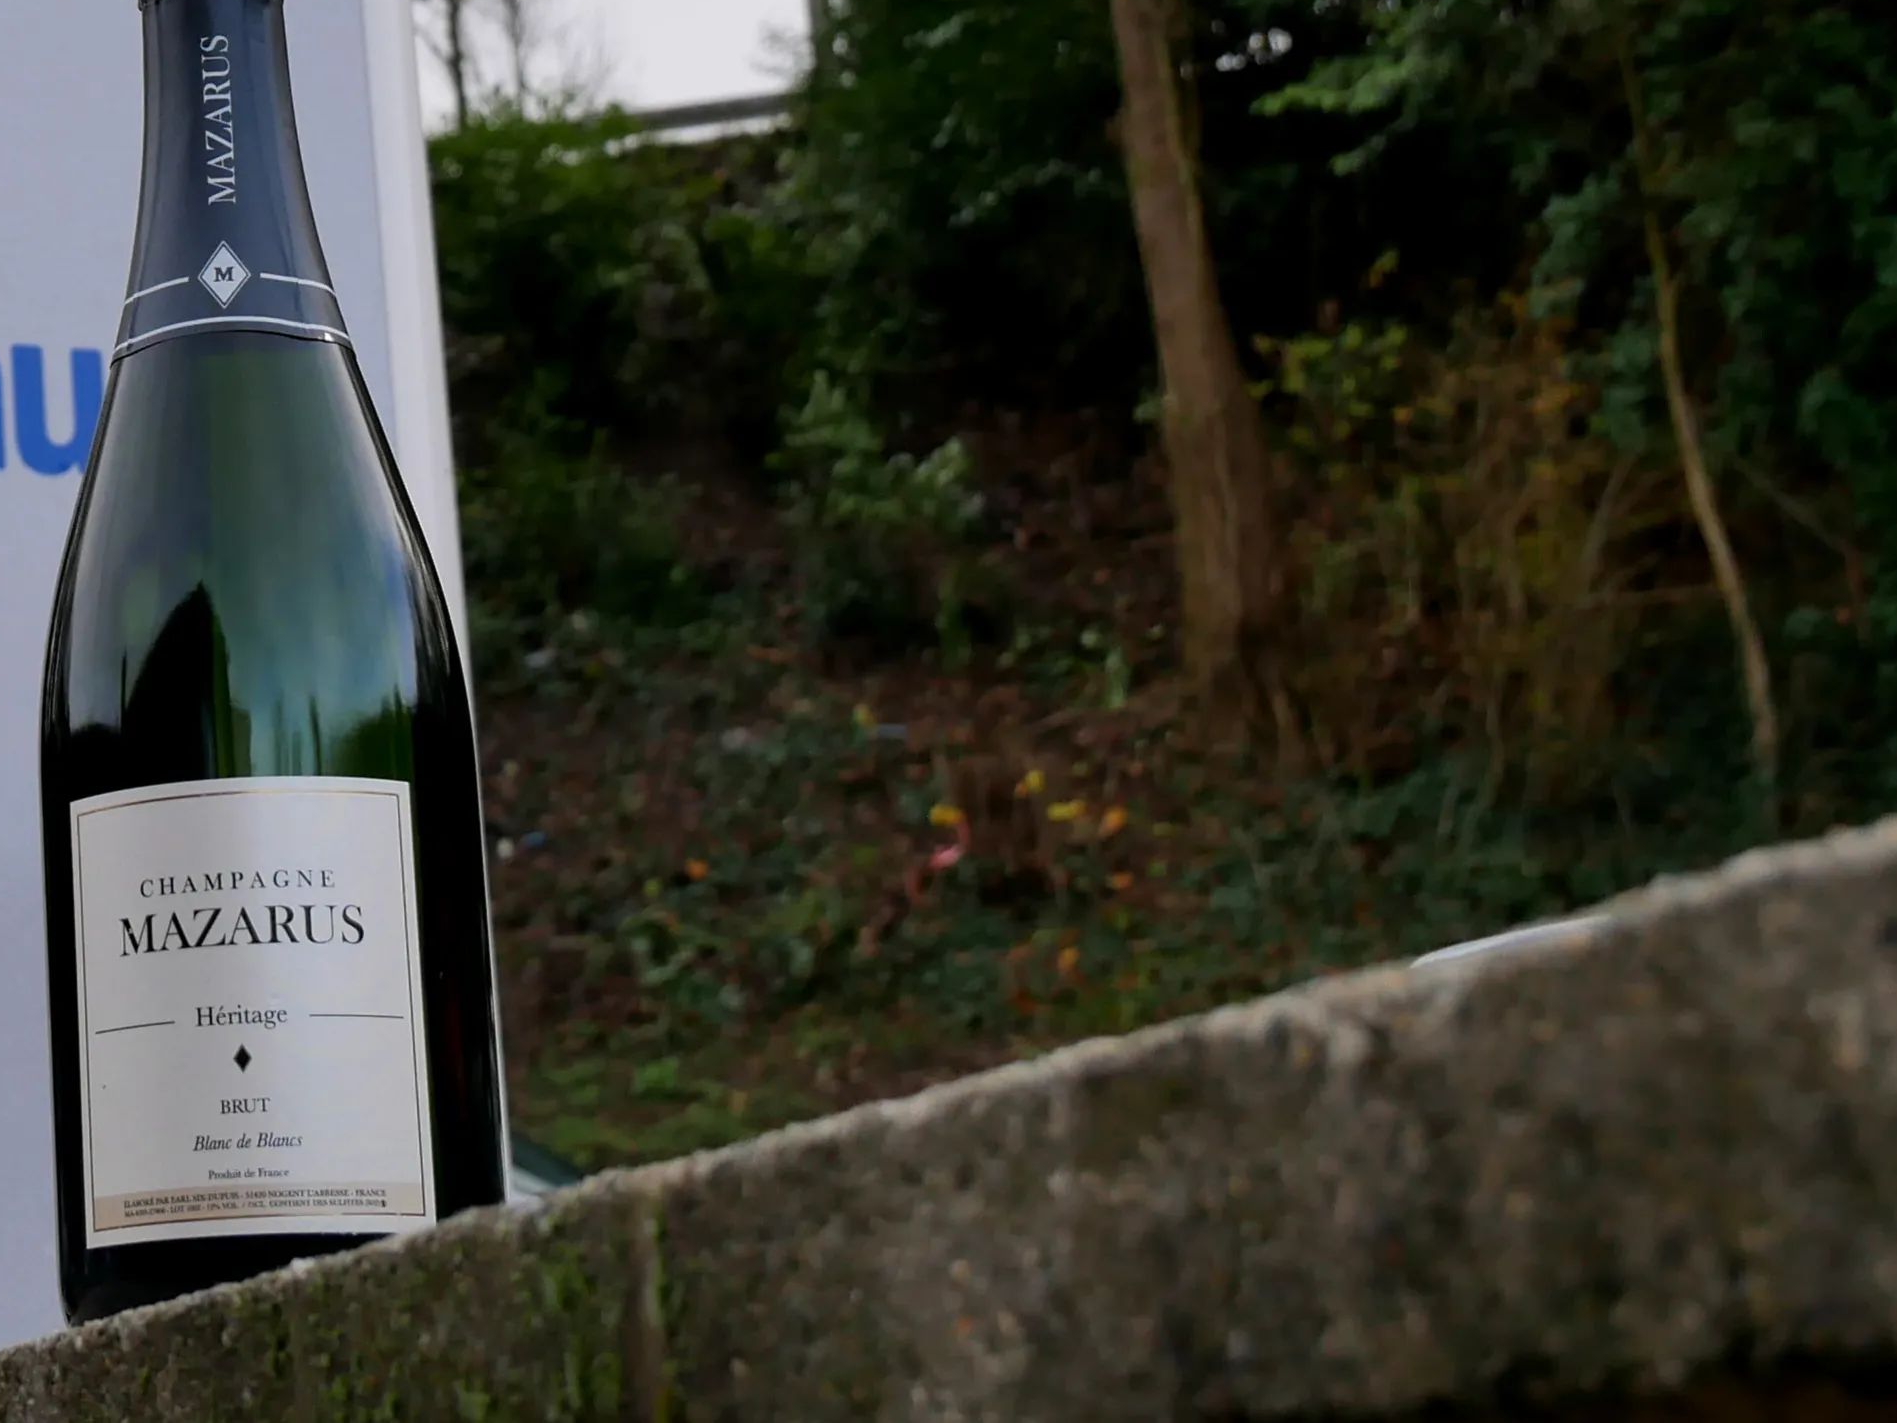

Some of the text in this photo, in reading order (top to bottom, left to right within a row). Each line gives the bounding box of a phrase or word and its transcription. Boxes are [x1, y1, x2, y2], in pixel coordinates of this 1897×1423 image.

[200, 34, 236, 205] MAZARUS
[213, 266, 235, 284] M
[139, 869, 336, 898] CHAMPAGNE
[118, 903, 366, 957] MAZARUS
[195, 1004, 288, 1029] Héritage
[220, 1098, 271, 1115] BRUT
[192, 1133, 303, 1152] Blanc de Blancs
[208, 1168, 289, 1180] Produit de France
